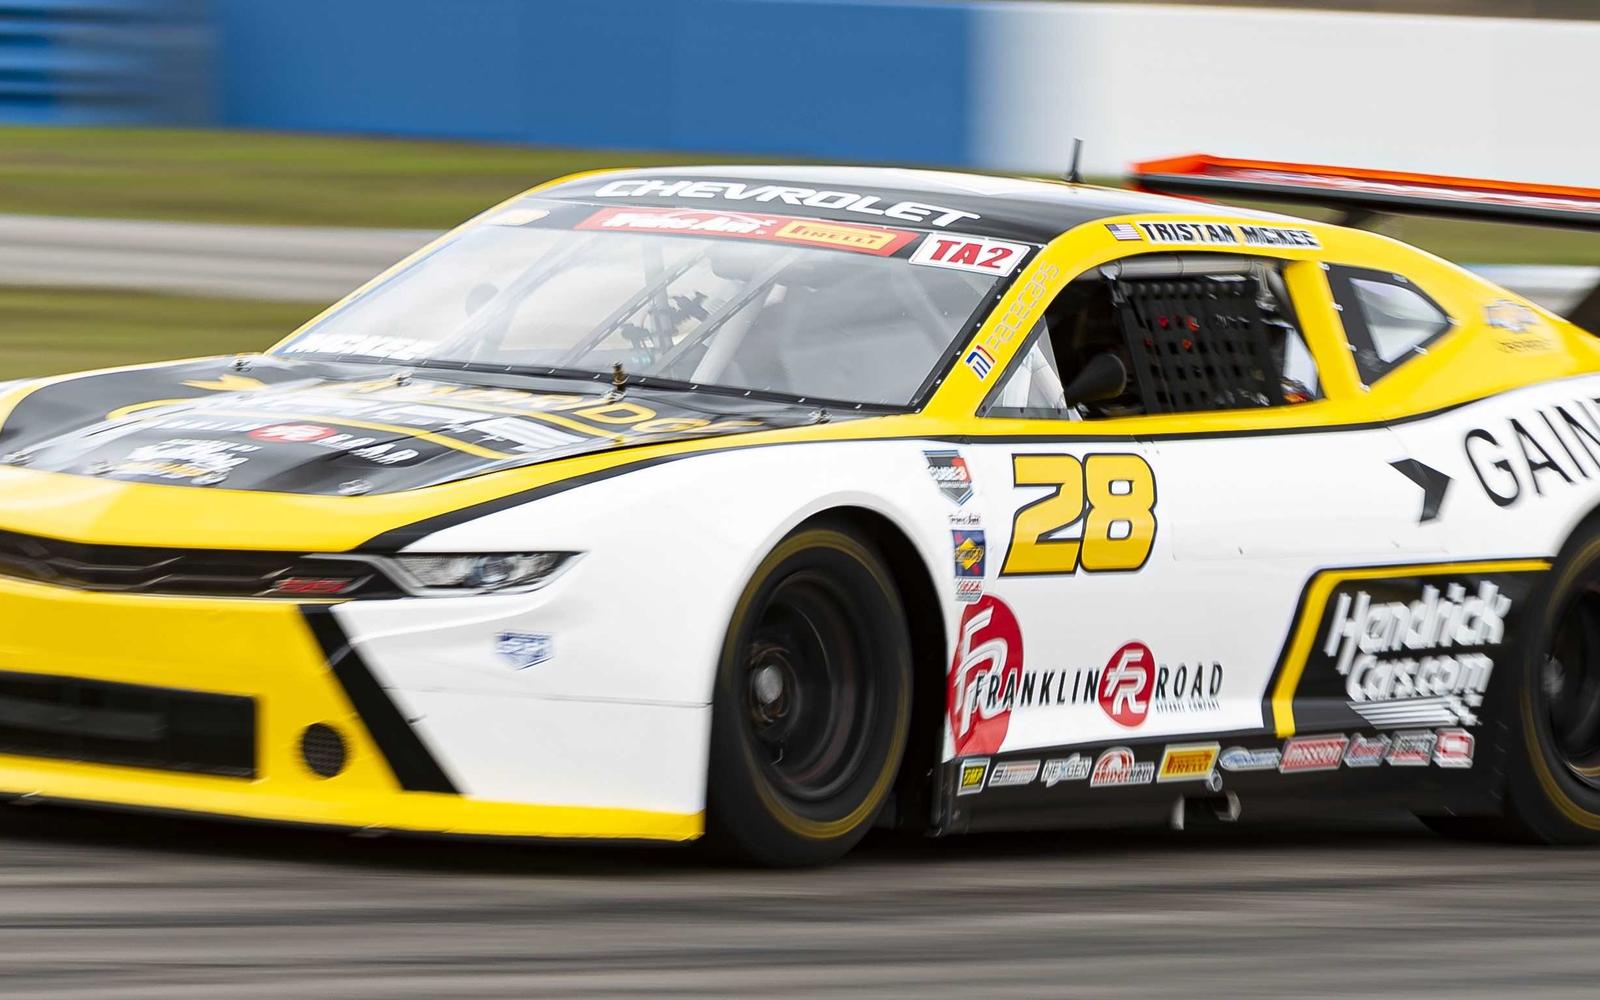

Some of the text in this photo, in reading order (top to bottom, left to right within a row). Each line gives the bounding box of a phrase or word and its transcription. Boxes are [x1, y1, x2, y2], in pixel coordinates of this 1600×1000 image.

[594, 179, 981, 228] CHEVROLET
[788, 223, 887, 246] PIRELLI
[930, 238, 1015, 270] TA2
[1139, 222, 1238, 243] TRISTAN
[1465, 397, 1600, 507] GAIN
[997, 452, 1158, 578] 28
[1324, 580, 1513, 676] Hendrick
[972, 667, 1100, 710] FRANKLIN
[1155, 662, 1223, 700] ROAD
